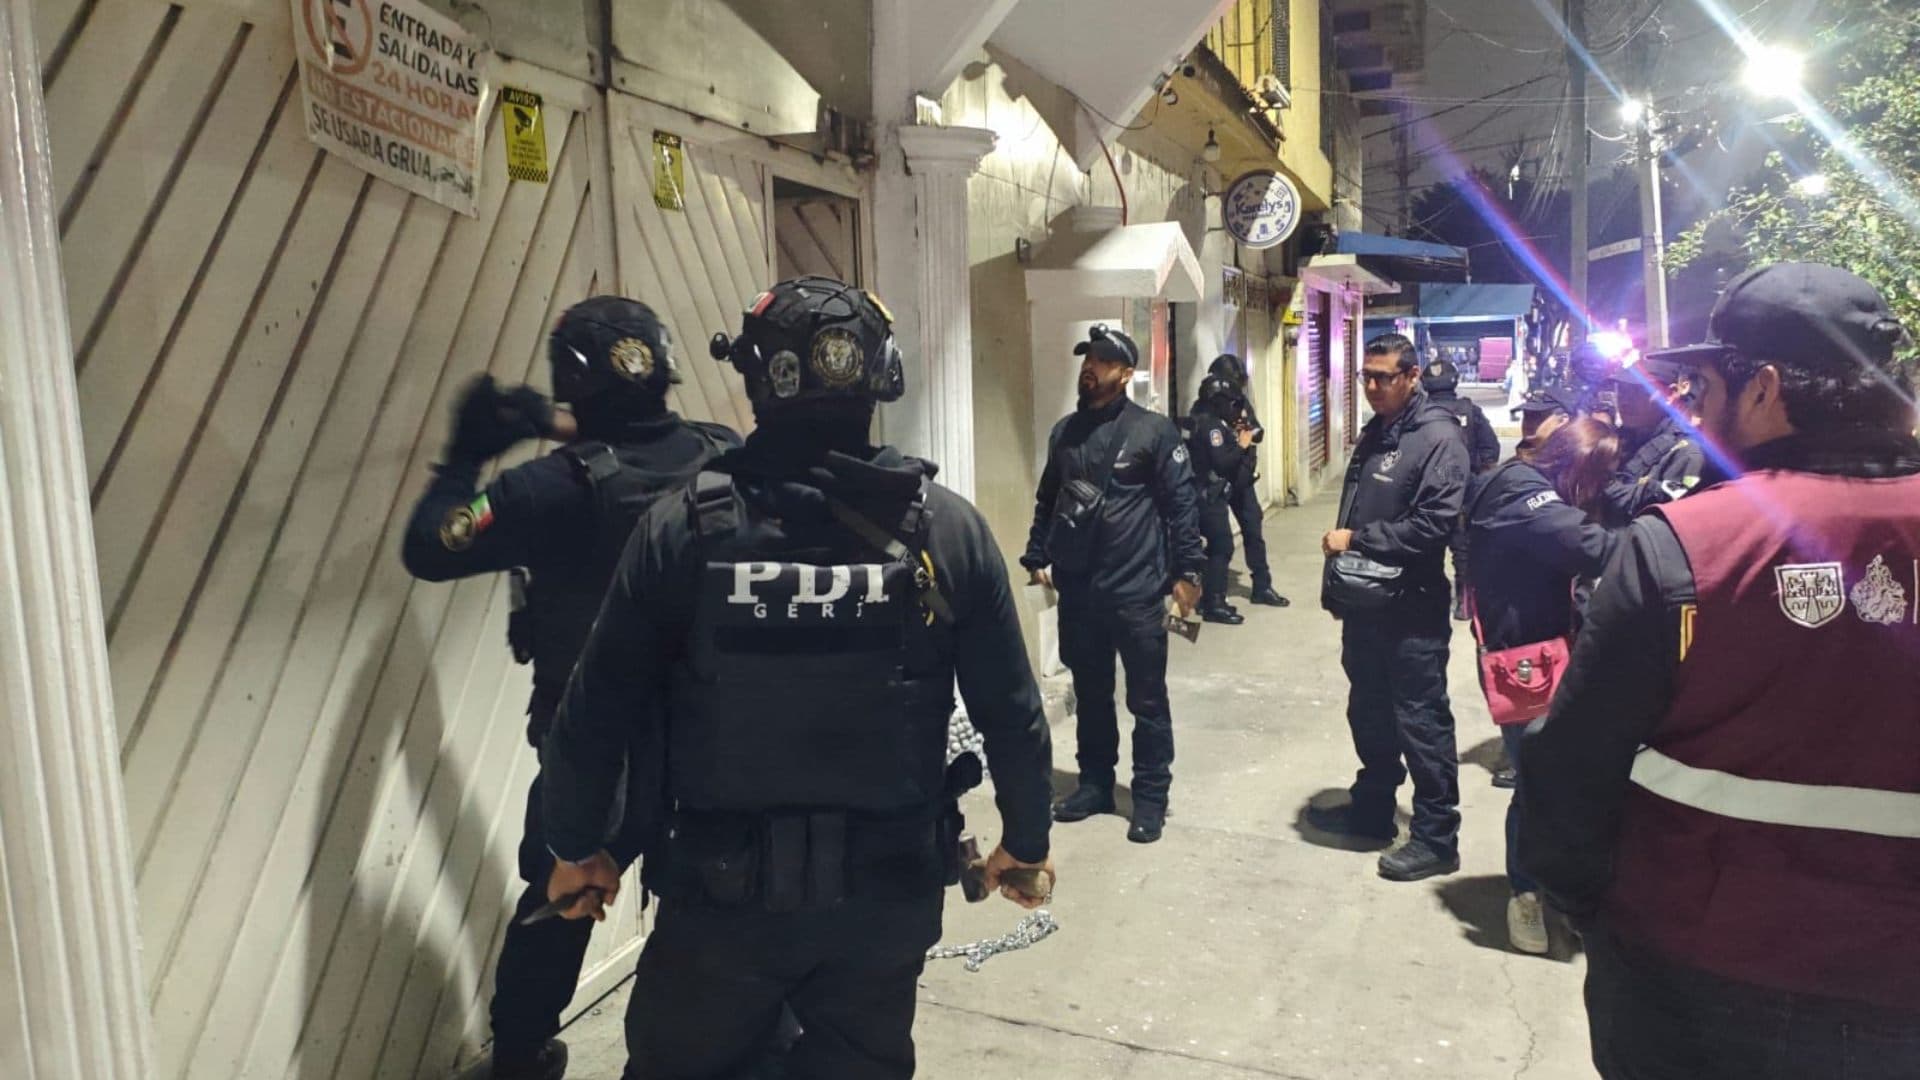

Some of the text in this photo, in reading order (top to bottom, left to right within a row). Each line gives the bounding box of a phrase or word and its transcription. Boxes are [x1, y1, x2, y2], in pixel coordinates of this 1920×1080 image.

[379, 2, 463, 62] ENTRADA
[372, 61, 401, 94] 24
[378, 32, 479, 97] SALIDA LAS
[508, 90, 536, 107] AVISO
[311, 102, 331, 136] SE
[331, 113, 384, 164] USARA
[727, 561, 889, 604] PDI
